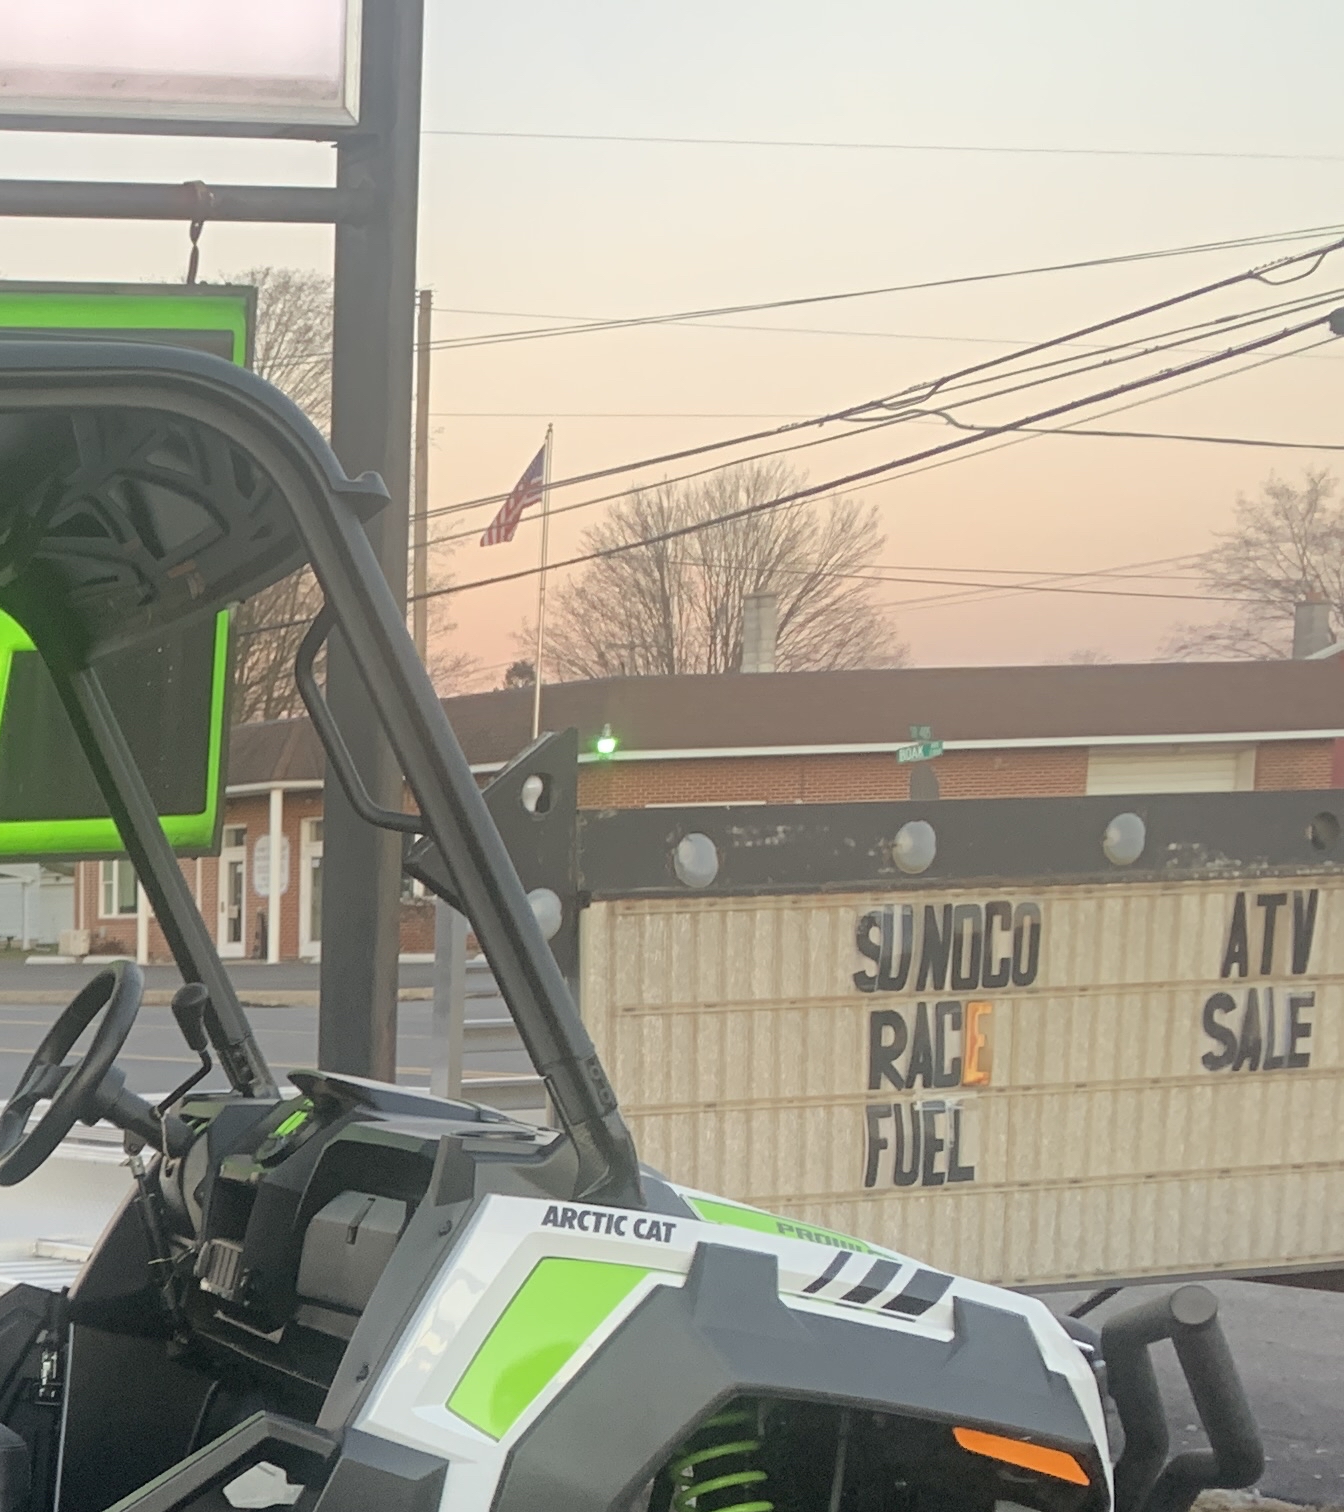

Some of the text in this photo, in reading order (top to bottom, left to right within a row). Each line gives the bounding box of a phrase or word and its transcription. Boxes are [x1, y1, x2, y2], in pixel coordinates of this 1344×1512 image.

[853, 888, 1318, 993] SUNOCO ATV
[868, 987, 1315, 1090] RACE SALE
[865, 1099, 974, 1187] FUEL
[541, 1205, 677, 1243] ARCTIC CAT
